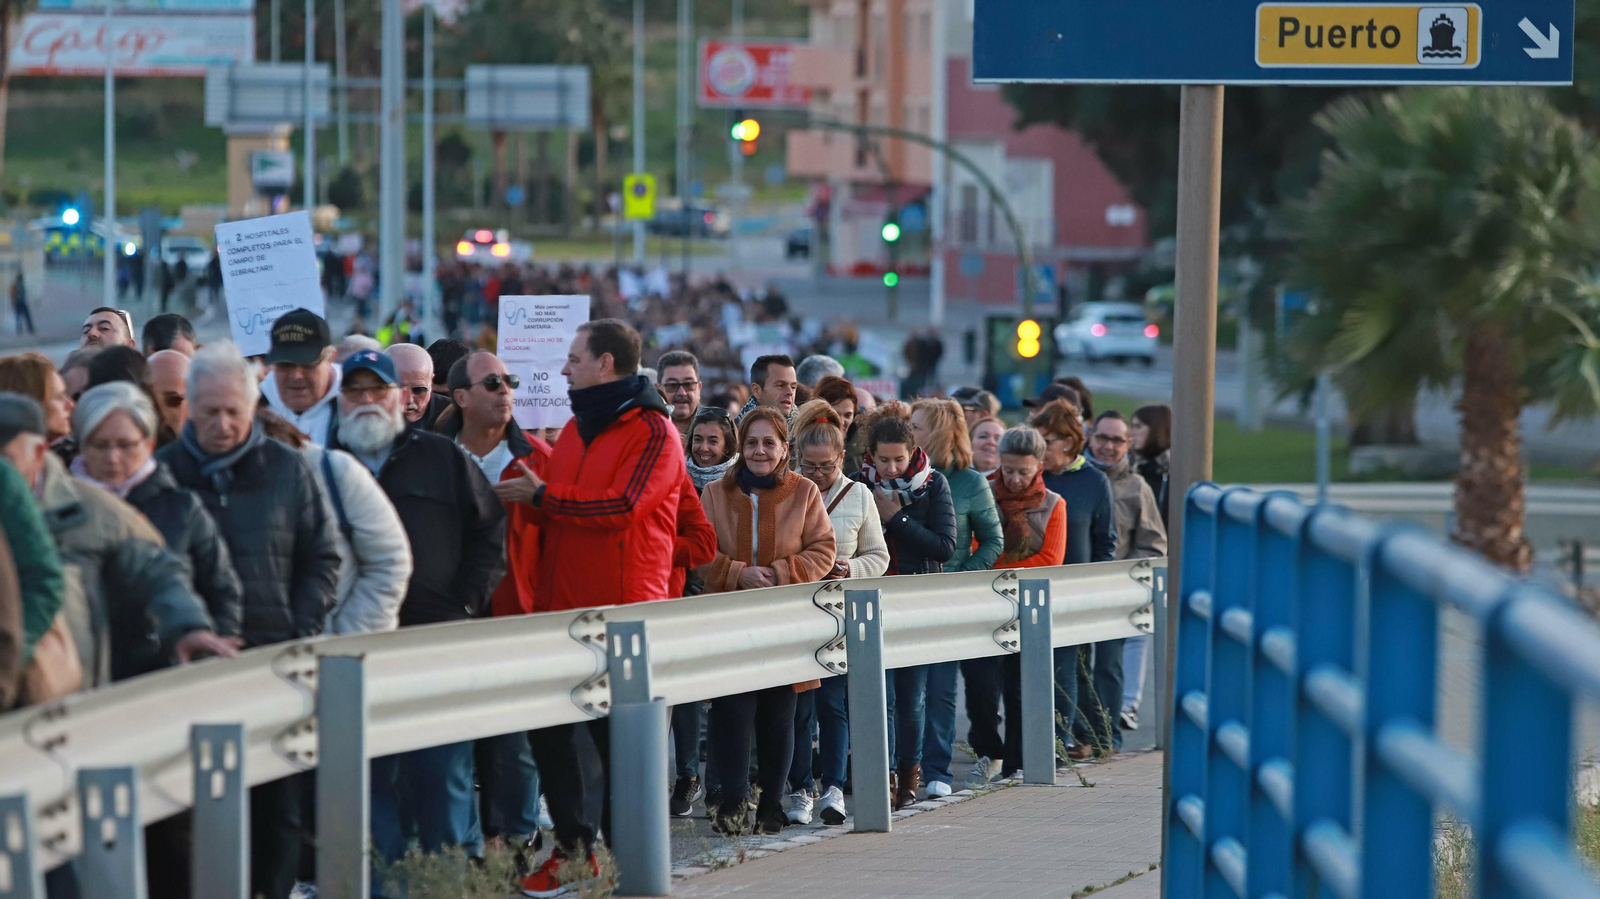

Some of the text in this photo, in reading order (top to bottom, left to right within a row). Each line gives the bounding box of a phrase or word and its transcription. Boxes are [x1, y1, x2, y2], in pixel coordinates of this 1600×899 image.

[1278, 16, 1401, 49] Puerto
[235, 233, 242, 242] 2
[245, 228, 289, 240] HOSPITALES
[227, 237, 303, 255] COMPLETOS PARA EL
[228, 254, 266, 266] CAMPO DE
[230, 265, 274, 276] GIBRALTAR!!
[261, 303, 294, 313] Contratos
[534, 372, 549, 381] NO
[528, 384, 551, 394] MÁS
